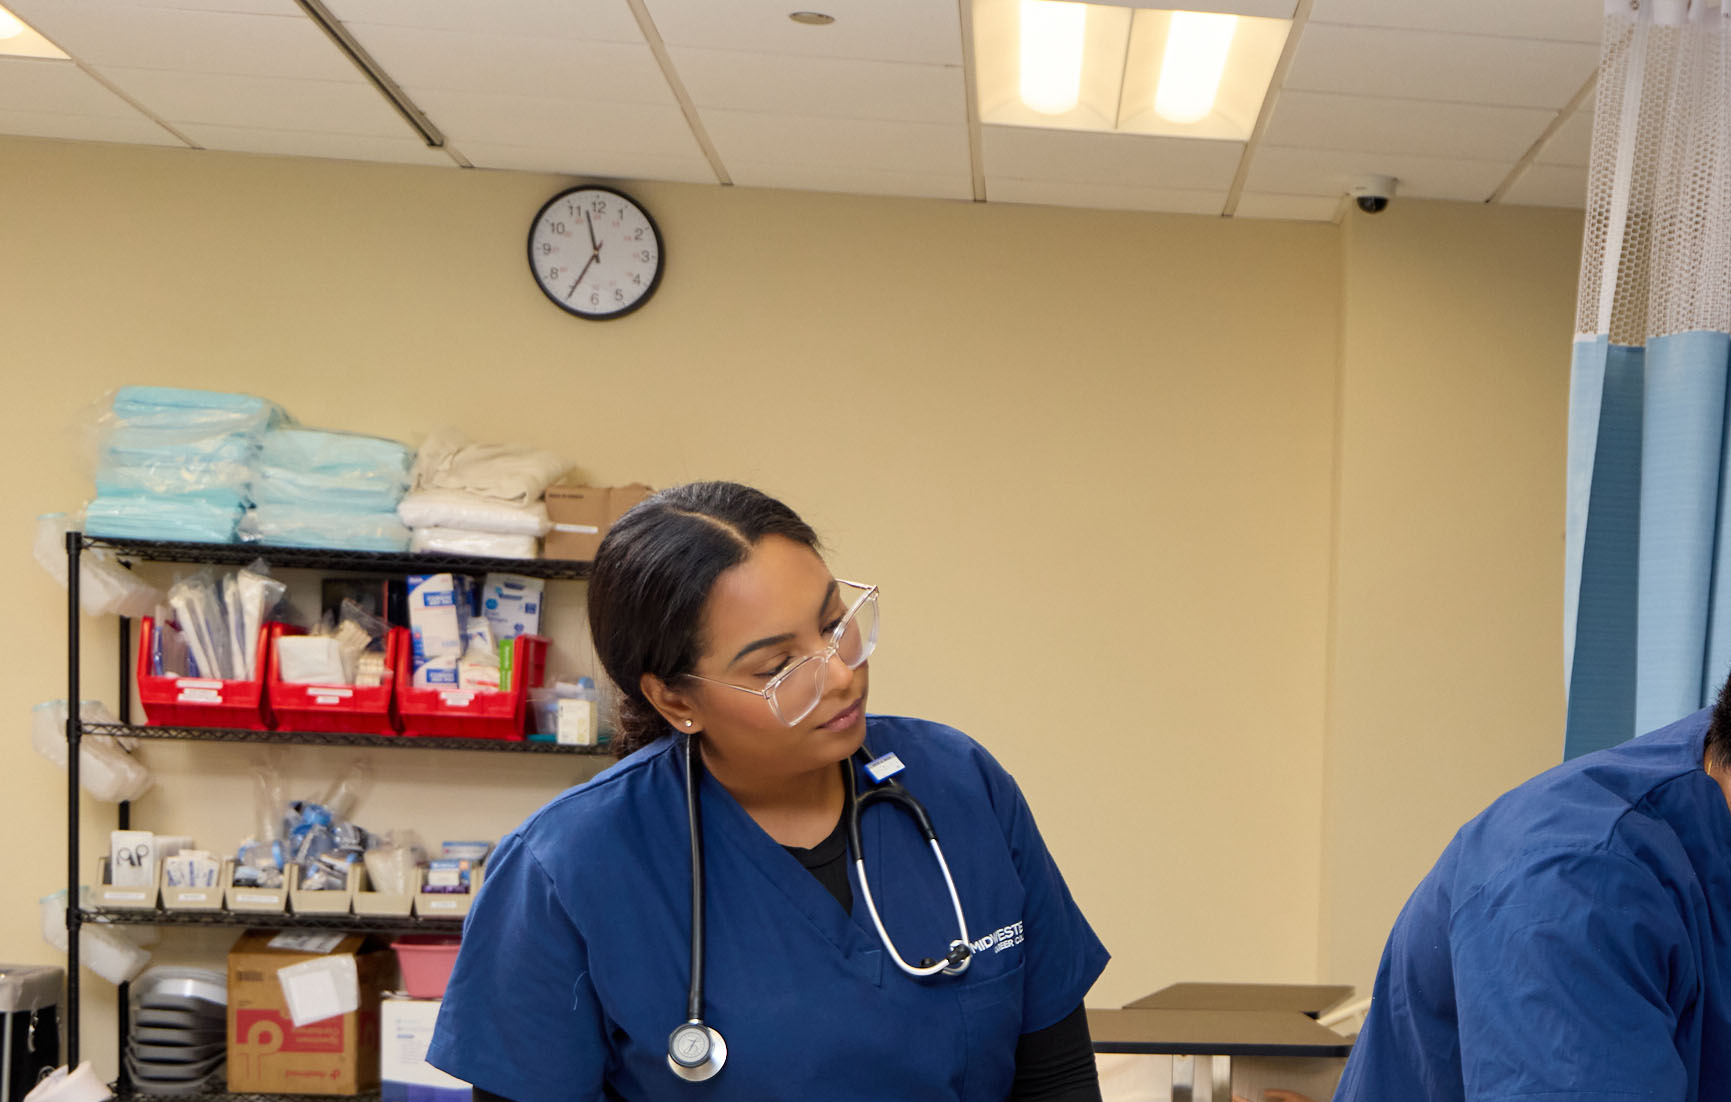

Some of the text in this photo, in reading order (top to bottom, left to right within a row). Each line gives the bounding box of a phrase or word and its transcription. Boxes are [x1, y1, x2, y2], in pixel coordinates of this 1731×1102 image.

[567, 204, 582, 217] 11
[591, 200, 607, 214] 12
[550, 221, 566, 234] 10
[634, 227, 644, 241] 2
[542, 242, 552, 255] 9
[641, 250, 650, 263] 3
[549, 266, 559, 280] 8
[632, 272, 641, 285] 4
[590, 292, 599, 306] 6
[614, 288, 624, 302] 5
